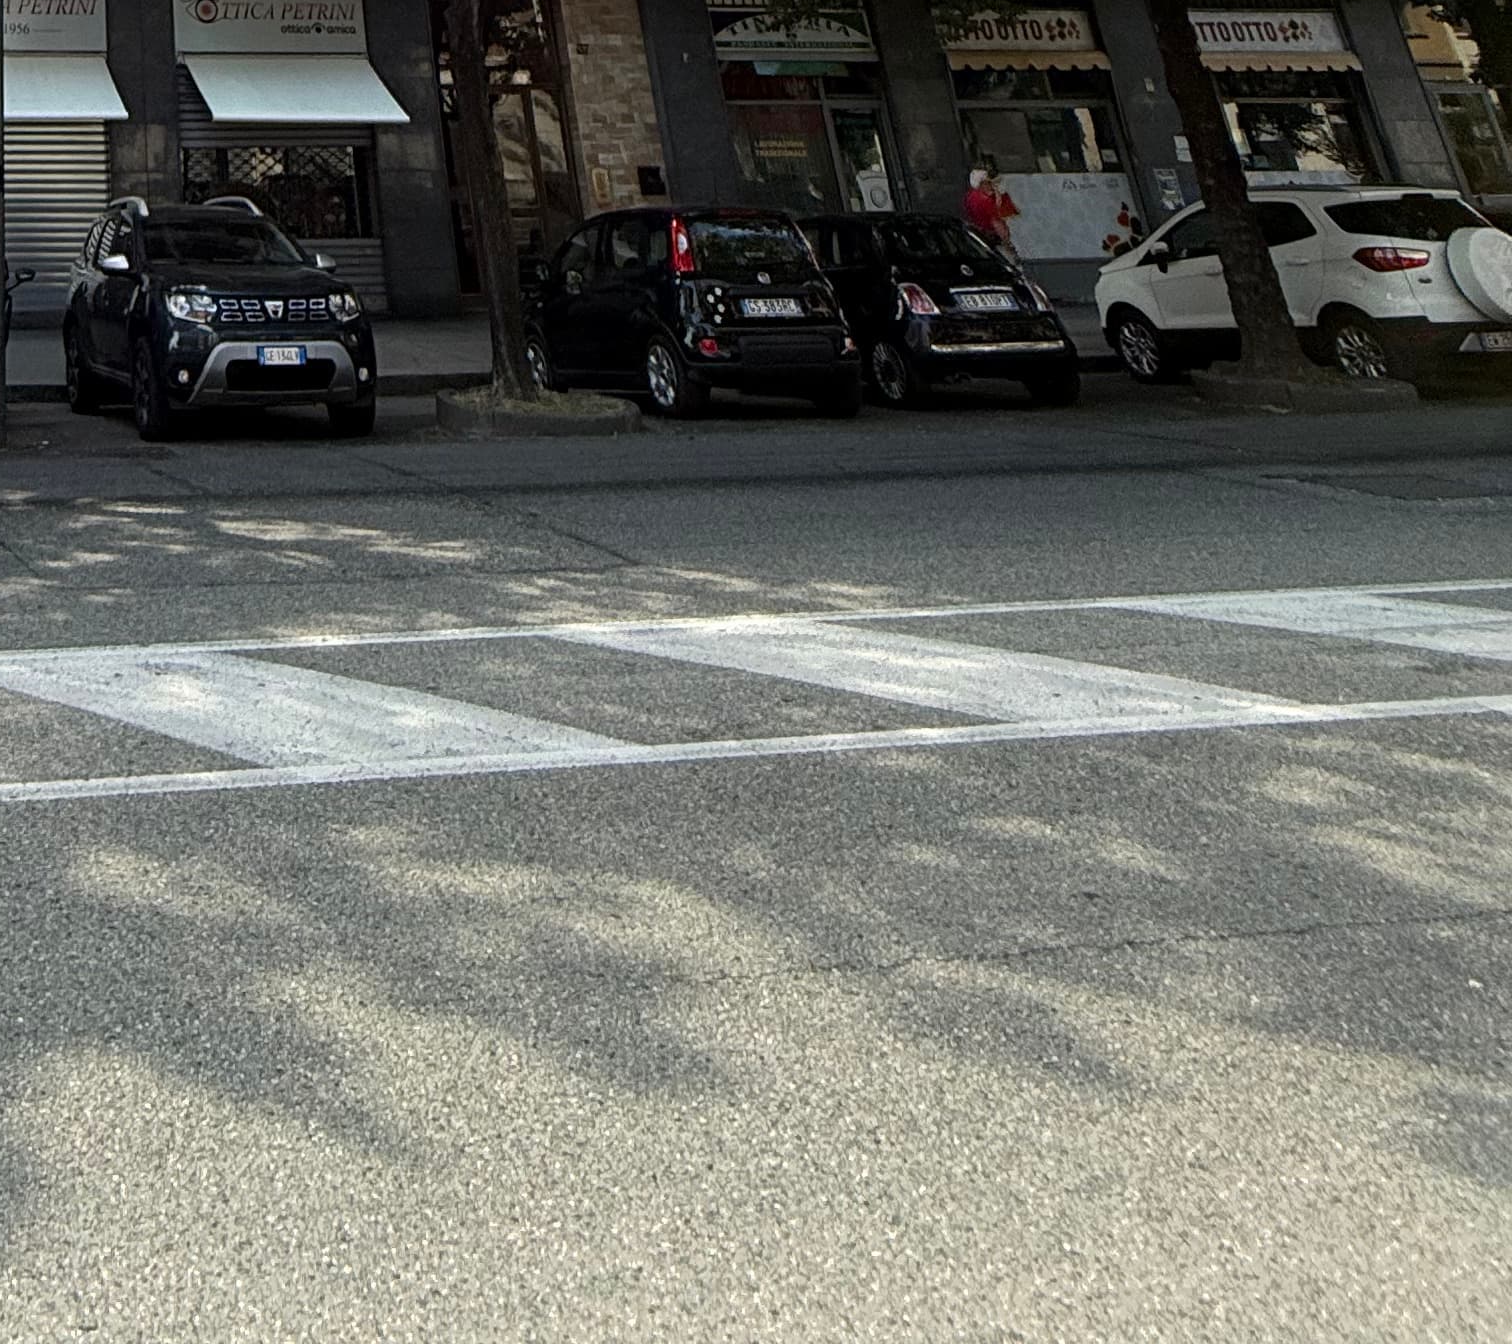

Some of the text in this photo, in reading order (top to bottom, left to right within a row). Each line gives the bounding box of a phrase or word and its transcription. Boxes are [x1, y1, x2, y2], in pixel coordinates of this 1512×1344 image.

[281, 2, 356, 21] PETRINI
[4, 23, 30, 34] 1956
[281, 24, 356, 34] ottica amica
